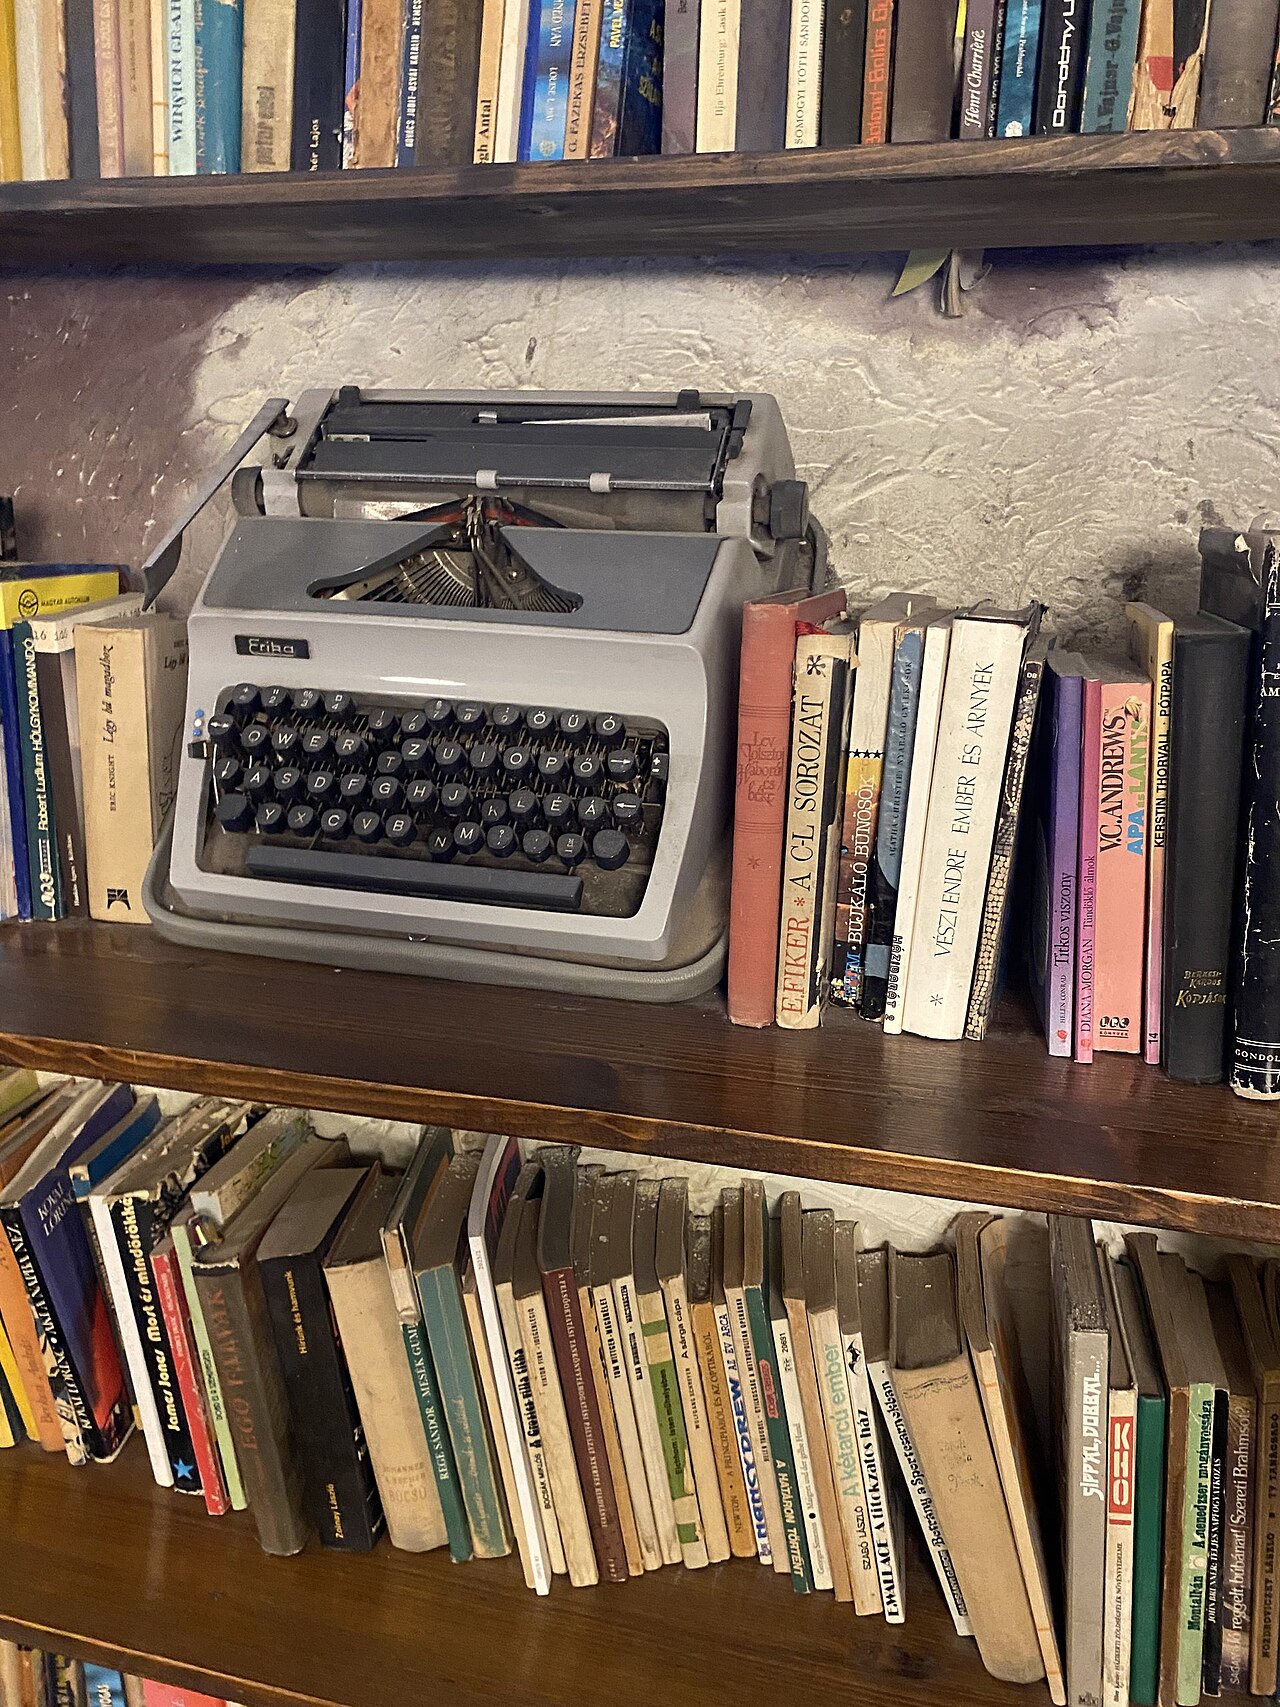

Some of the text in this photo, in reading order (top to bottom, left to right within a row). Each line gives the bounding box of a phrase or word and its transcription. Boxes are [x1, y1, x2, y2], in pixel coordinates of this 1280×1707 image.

[609, 16, 623, 48] PAVEL
[1052, 18, 1075, 128] Dorothy
[571, 73, 583, 135] FAZEKAS
[794, 51, 808, 145] SOMOGYI TÓTH
[964, 89, 981, 128] Henri
[405, 120, 416, 147] KOVÁCS
[479, 99, 492, 140] Antal
[99, 645, 116, 698] magadhoz
[22, 638, 42, 751] HÖLGYKOMMANDÓ
[567, 715, 616, 731] Ü Ó
[278, 732, 557, 768] W E R Z U O P
[1153, 660, 1173, 848] KERSTIN THORVALL PÓTPAPA
[33, 754, 46, 792] Ludlum
[107, 754, 116, 789] KNIGHT
[35, 795, 49, 831] Robert
[108, 792, 117, 812] ERIC
[249, 772, 597, 816] A S D F G H J É Á
[932, 661, 995, 957] VÉSZI ENDRE EMBER ÉS ÁRNYÉK
[265, 809, 474, 840] Y C B M
[889, 822, 900, 857] AGATHA
[1127, 809, 1146, 855] APA
[780, 694, 825, 1015] E.FIKER A C-L SOROZAT
[1084, 855, 1097, 883] álmok
[844, 862, 868, 944] BÚJKÁLÓ
[1053, 872, 1075, 968] Titkos viszony
[886, 934, 905, 1008] HÁZIBARÁT
[1081, 939, 1095, 992] MORGAN
[1059, 976, 1068, 1001] CONRAD
[1079, 995, 1093, 1033] DIANA
[1148, 1033, 1160, 1046] 14
[118, 1197, 150, 1285] mindörökké
[136, 1288, 153, 1303] és
[283, 1270, 301, 1312] hamvunk
[142, 1304, 162, 1342] Most
[292, 1312, 303, 1324] és
[672, 1298, 684, 1323] cápa
[719, 1313, 732, 1337] ARCA
[675, 1324, 689, 1350] sárga
[680, 1350, 690, 1360] A
[723, 1342, 735, 1354] ÉV
[153, 1349, 172, 1388] Jones
[611, 1365, 621, 1379] TOM
[162, 1388, 181, 1431] James
[710, 1384, 721, 1397] AZ
[425, 1405, 444, 1450] SÁNDOR
[728, 1376, 752, 1455] DREW
[857, 1407, 873, 1438] ház
[436, 1451, 450, 1480] REGE
[533, 1452, 547, 1480] MIKLÓS
[821, 1341, 871, 1570] SZABÓ LÁSZLÓ A kétarcú ember
[861, 1441, 884, 1520] titokzatos
[730, 1495, 744, 1534] NEWTON
[775, 1459, 805, 1578] A HATÁRON TÖRTÉNT
[1229, 1480, 1248, 1525] Szereti
[873, 1521, 887, 1533] A
[1191, 1540, 1206, 1549] A
